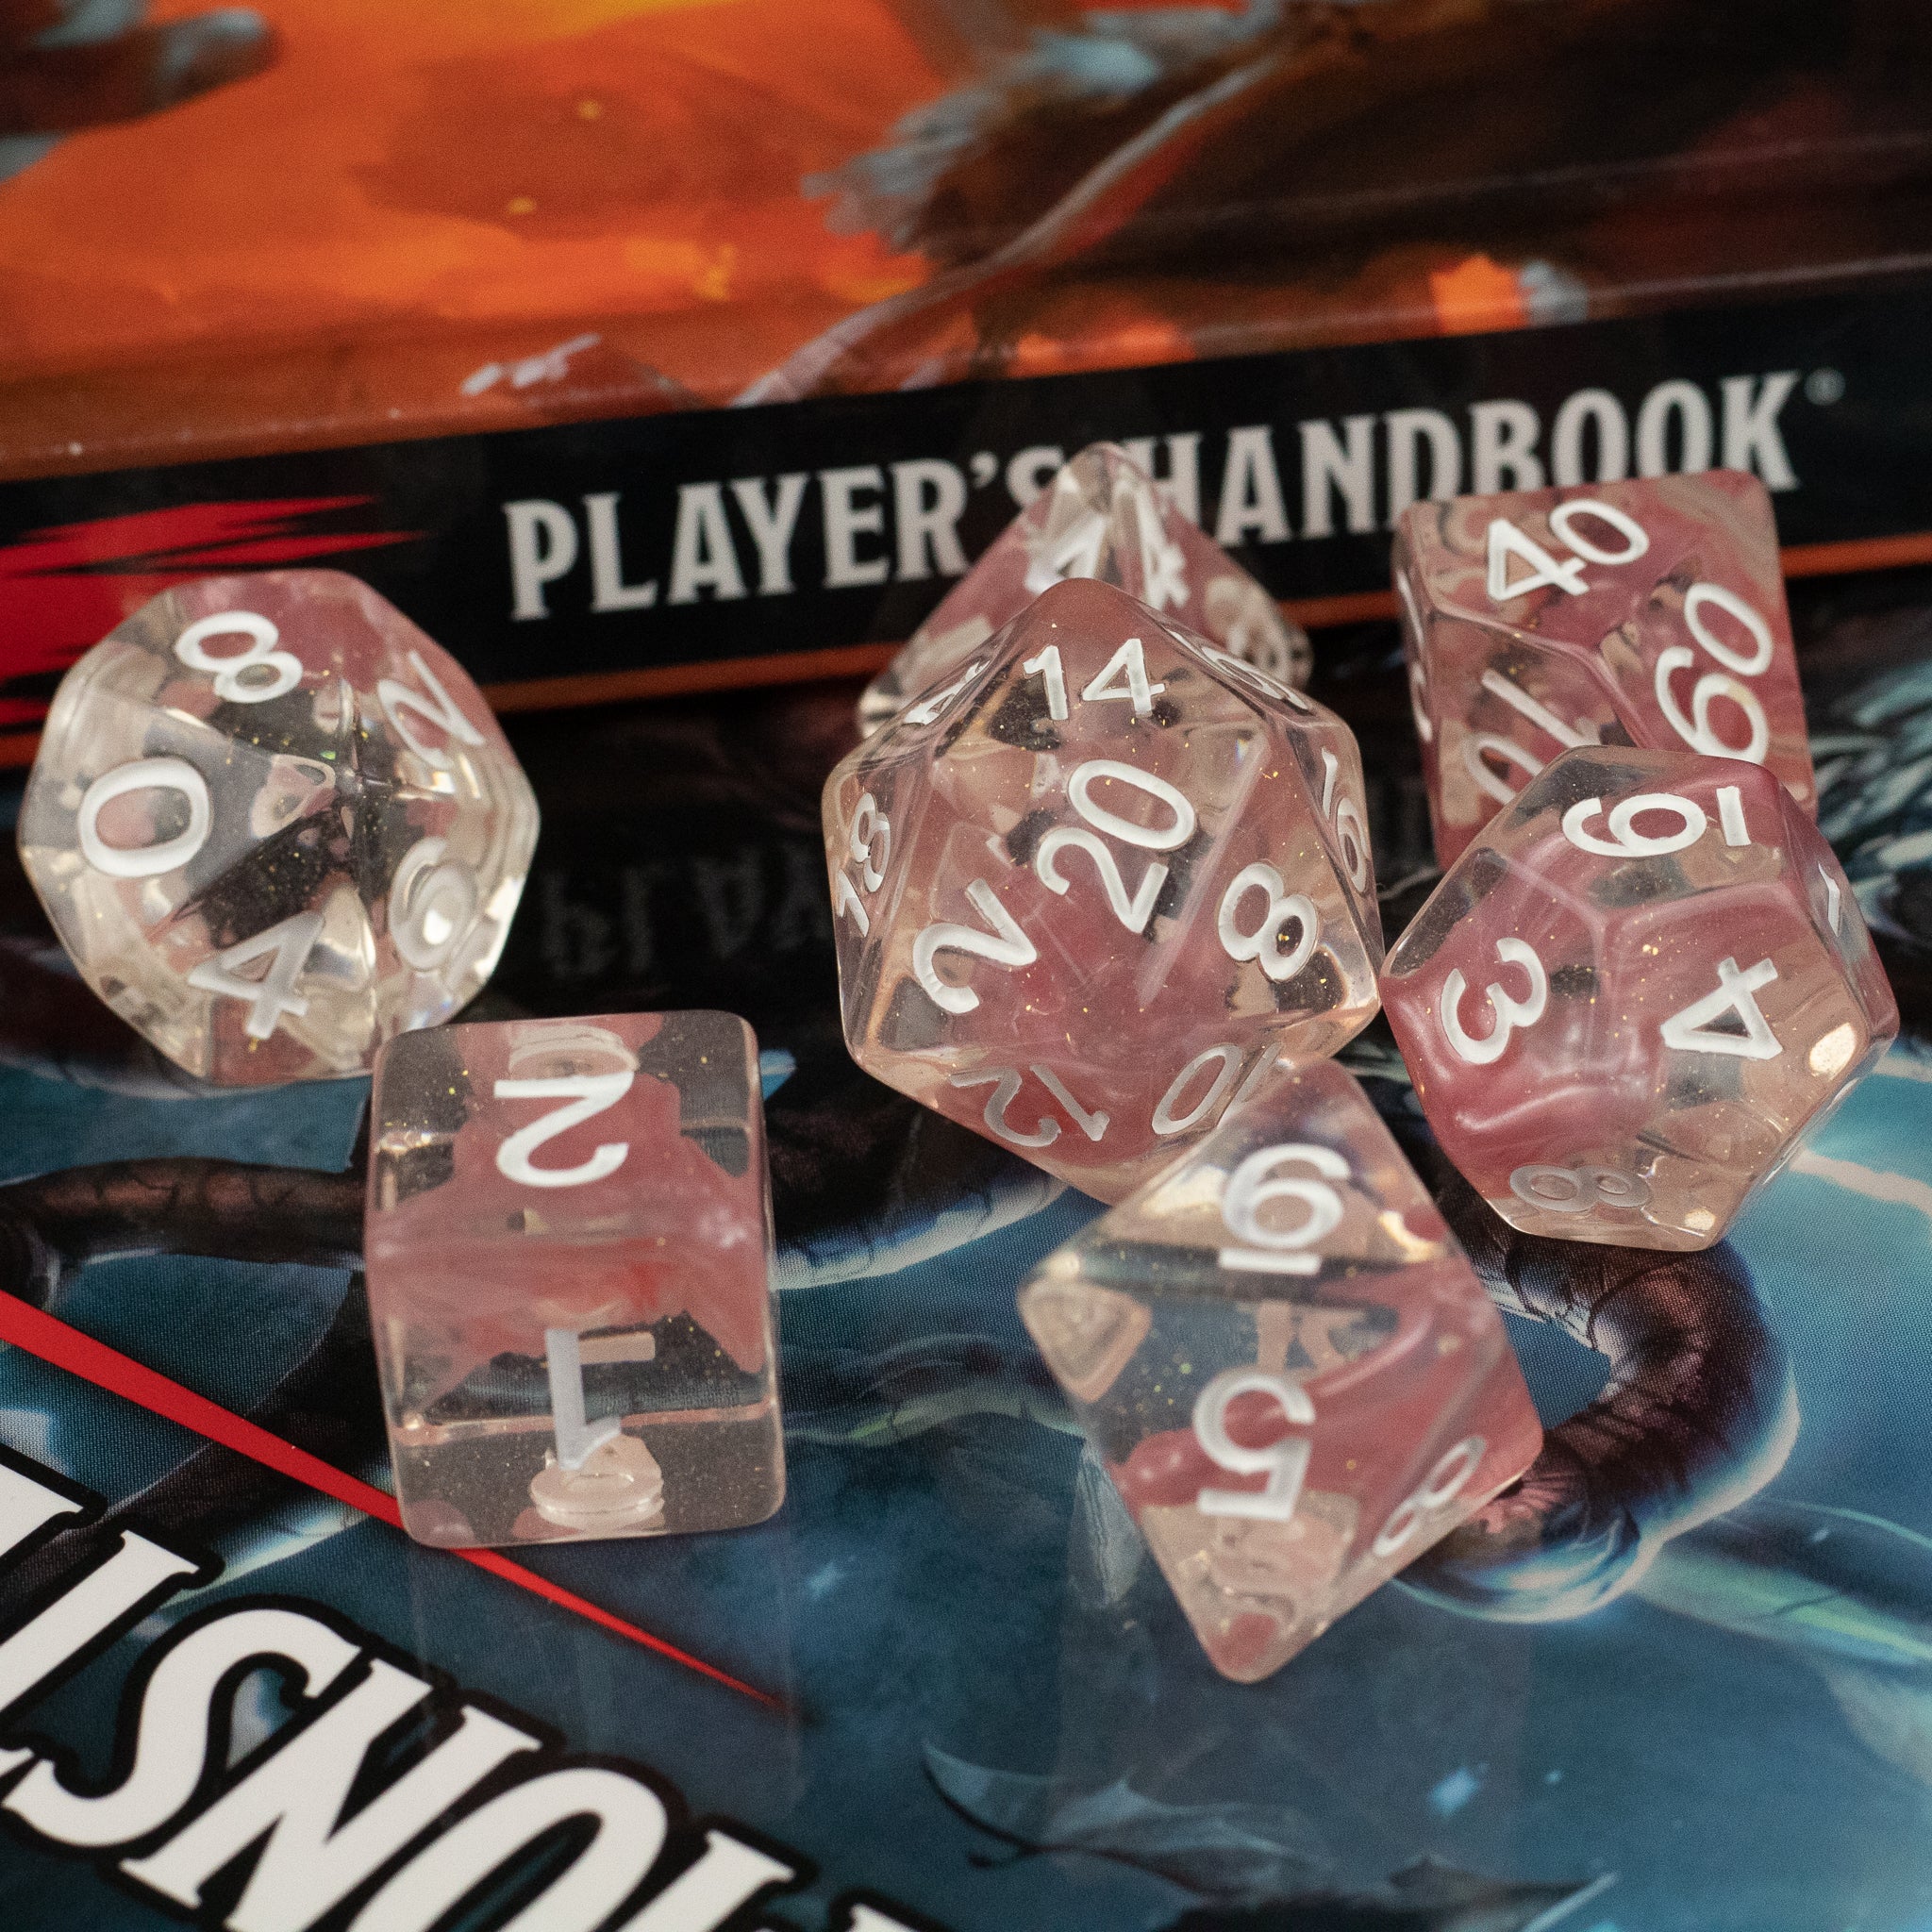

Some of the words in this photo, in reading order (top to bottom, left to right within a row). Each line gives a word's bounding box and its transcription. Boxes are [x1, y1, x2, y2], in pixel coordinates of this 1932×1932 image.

[1121, 370, 1801, 545] HANDBOOK
[1487, 498, 1649, 601] 40
[175, 610, 304, 704] 8
[378, 650, 485, 770] 2
[1023, 638, 1167, 722] 14
[1656, 582, 1774, 766] 60
[77, 757, 213, 878] 0
[1037, 758, 1199, 934] 20
[189, 911, 325, 1040] 4
[912, 878, 1039, 1014] 2
[1219, 862, 1320, 983] 8
[1441, 937, 1547, 1064] 3
[1661, 957, 1783, 1060] 4
[493, 1072, 635, 1188] 2
[1191, 1372, 1317, 1522] 5
[1374, 1437, 1488, 1557] 8
